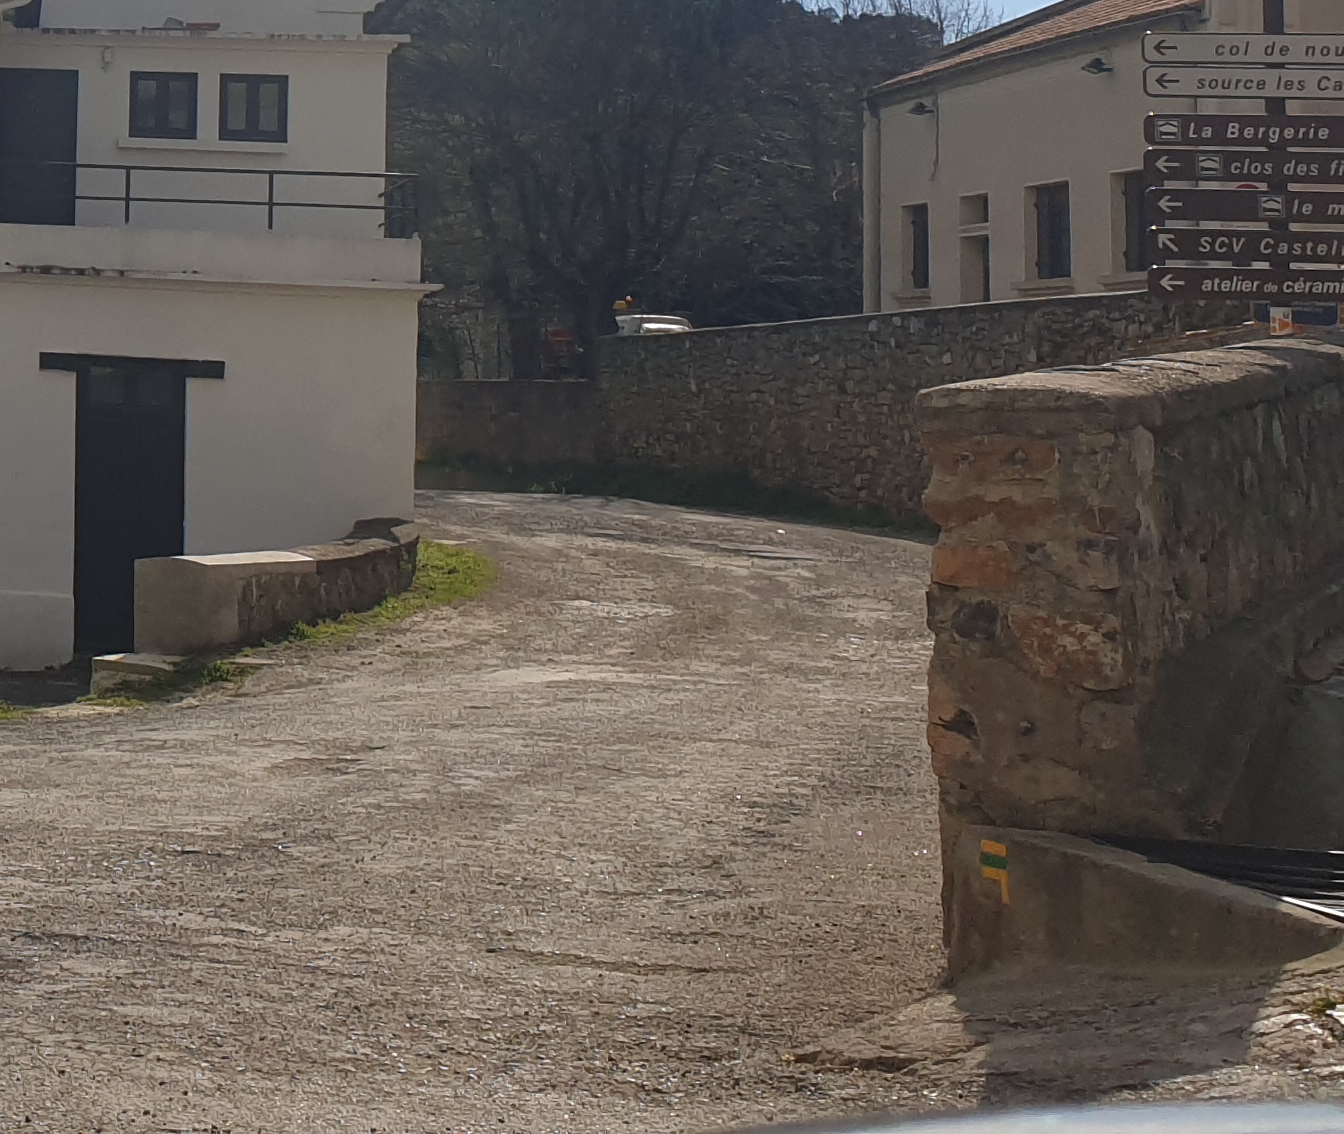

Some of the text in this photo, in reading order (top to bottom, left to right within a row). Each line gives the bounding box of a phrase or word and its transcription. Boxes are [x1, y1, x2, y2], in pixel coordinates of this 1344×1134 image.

[1214, 41, 1250, 56] col
[1264, 41, 1290, 57] de
[1196, 74, 1344, 92] source les Ca
[1188, 122, 1330, 143] La Bergerie
[1230, 158, 1273, 175] clos
[1283, 159, 1319, 176] des
[1292, 199, 1313, 215] le
[1198, 236, 1344, 256] SCV Castel
[1201, 276, 1261, 292] atelier
[1264, 282, 1278, 293] de
